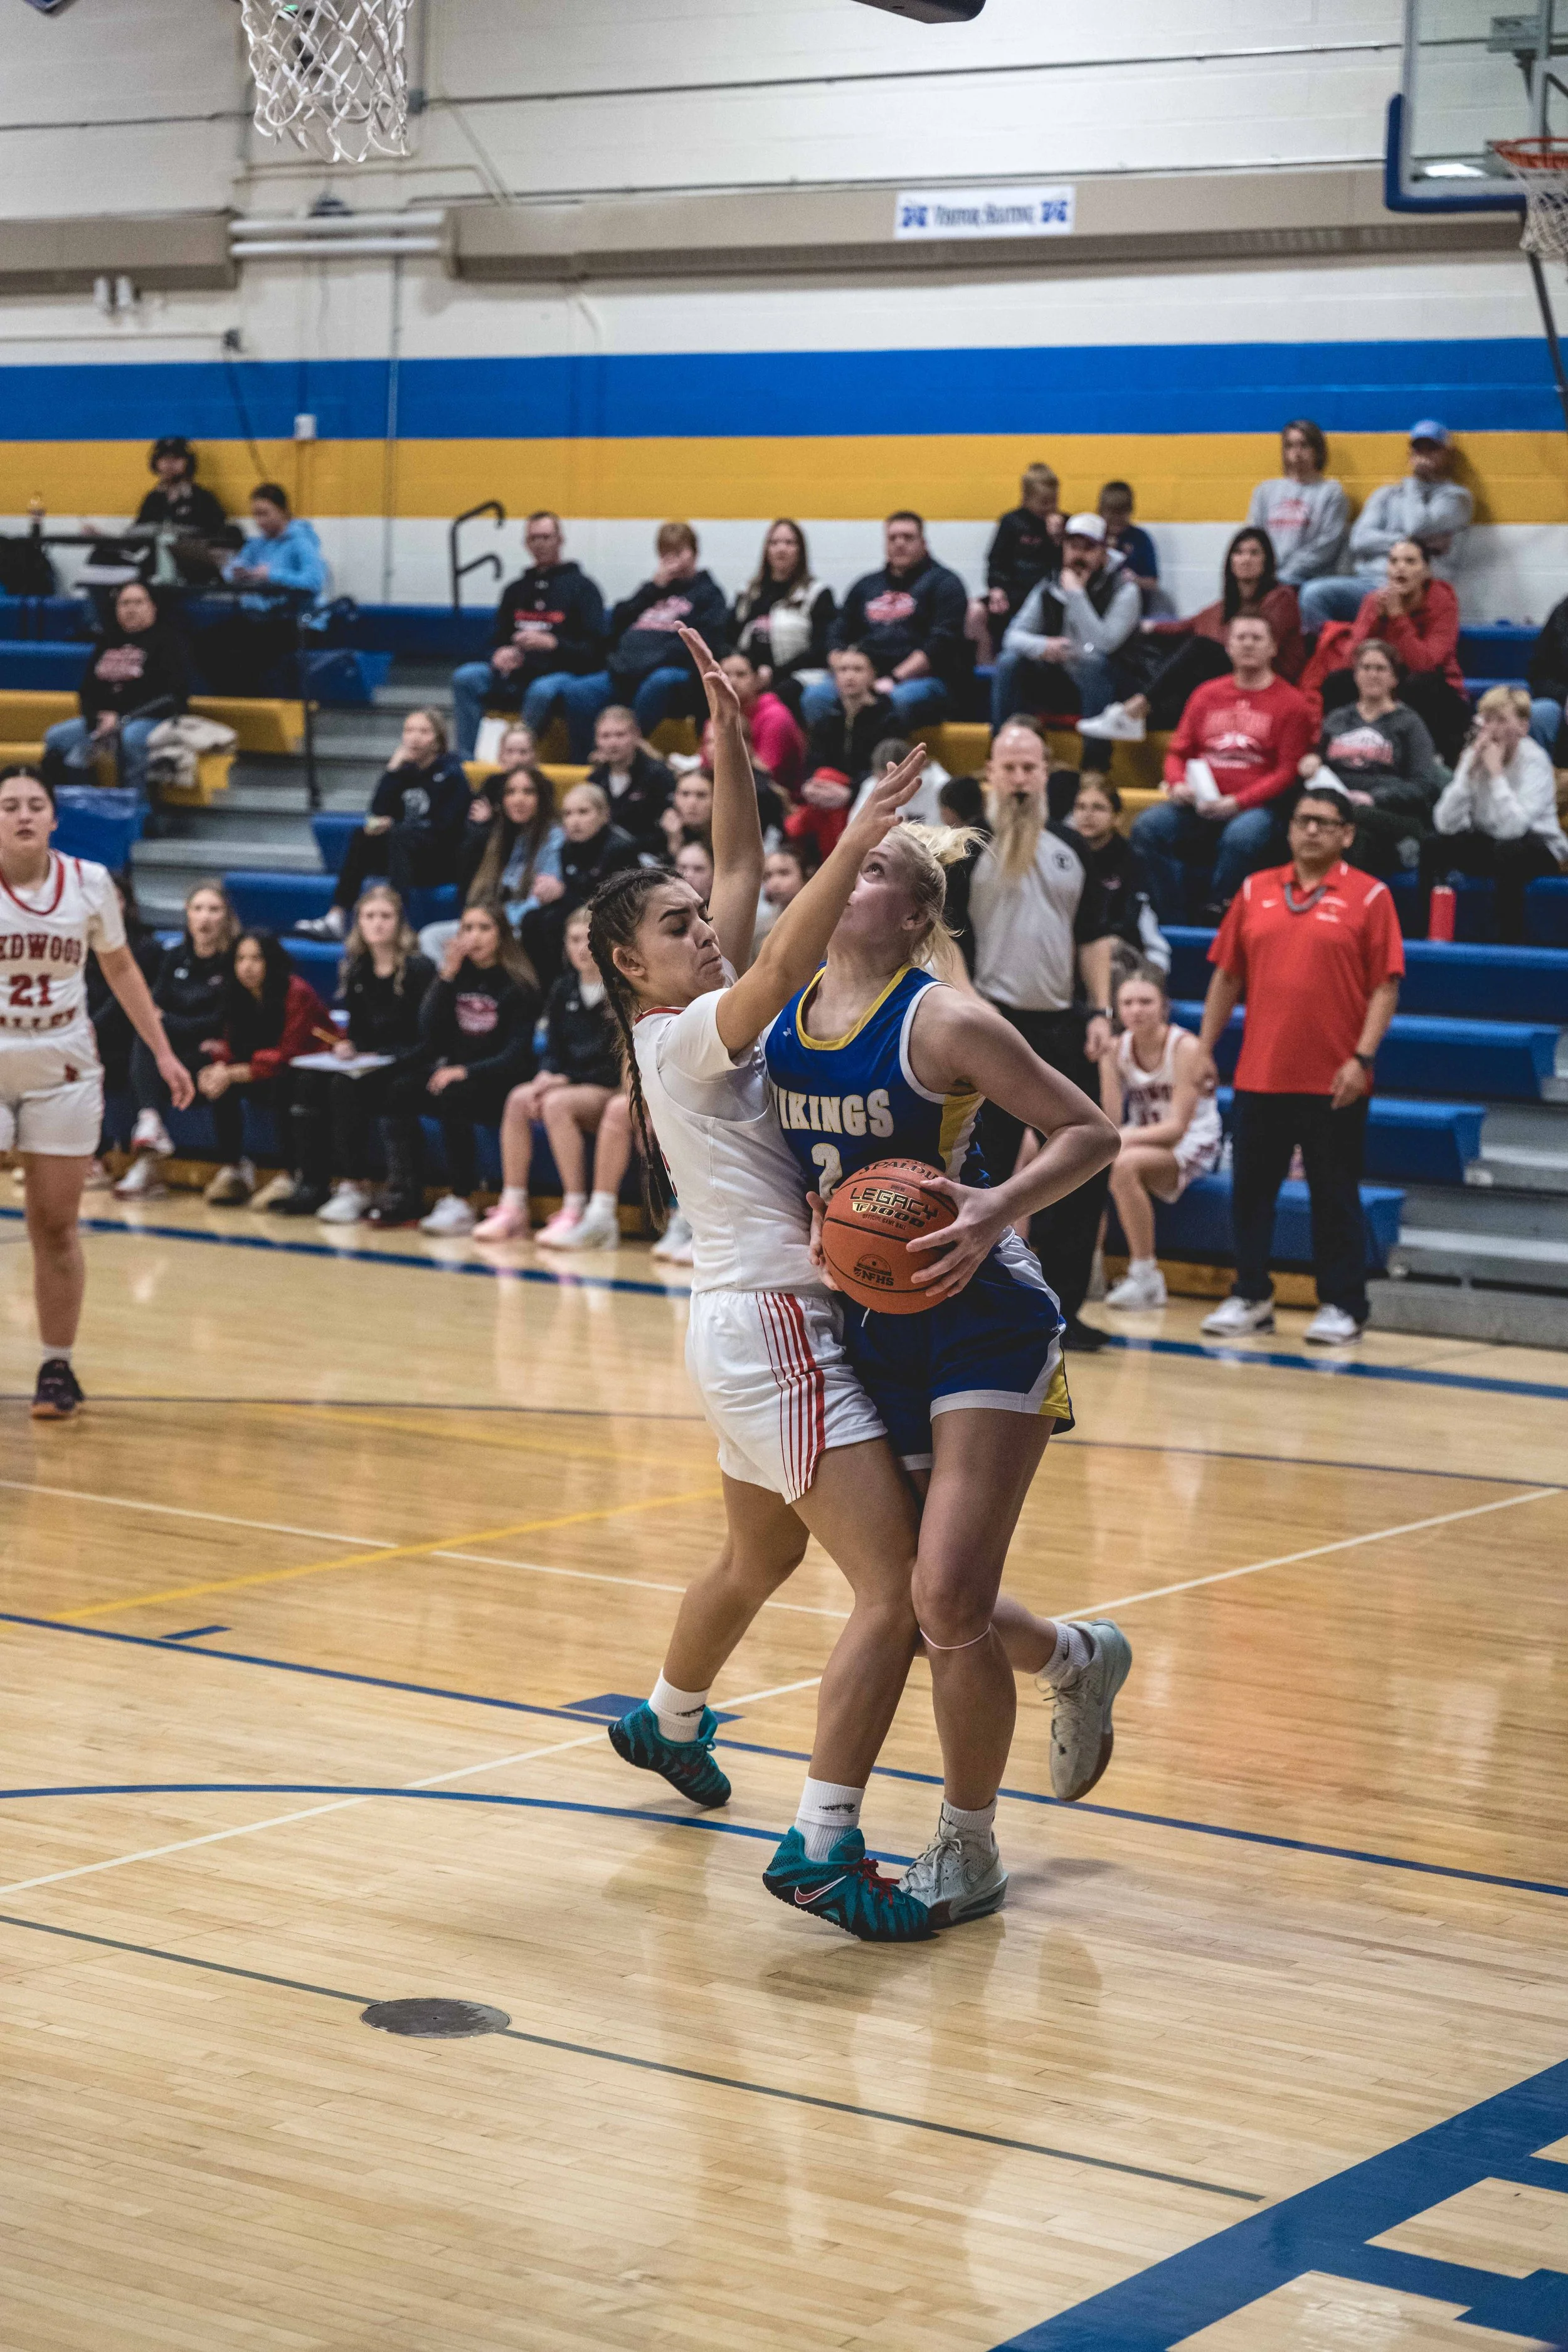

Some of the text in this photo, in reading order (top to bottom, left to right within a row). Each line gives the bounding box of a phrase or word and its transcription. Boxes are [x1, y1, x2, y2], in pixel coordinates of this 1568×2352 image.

[10, 974, 53, 1007] 21
[811, 1143, 842, 1205] 2
[850, 1187, 938, 1221] LEGACY
[869, 1204, 925, 1228] 1000
[862, 1214, 881, 1222] OFFICIAL
[882, 1217, 895, 1226] GAME
[862, 1269, 894, 1286] NFHS
